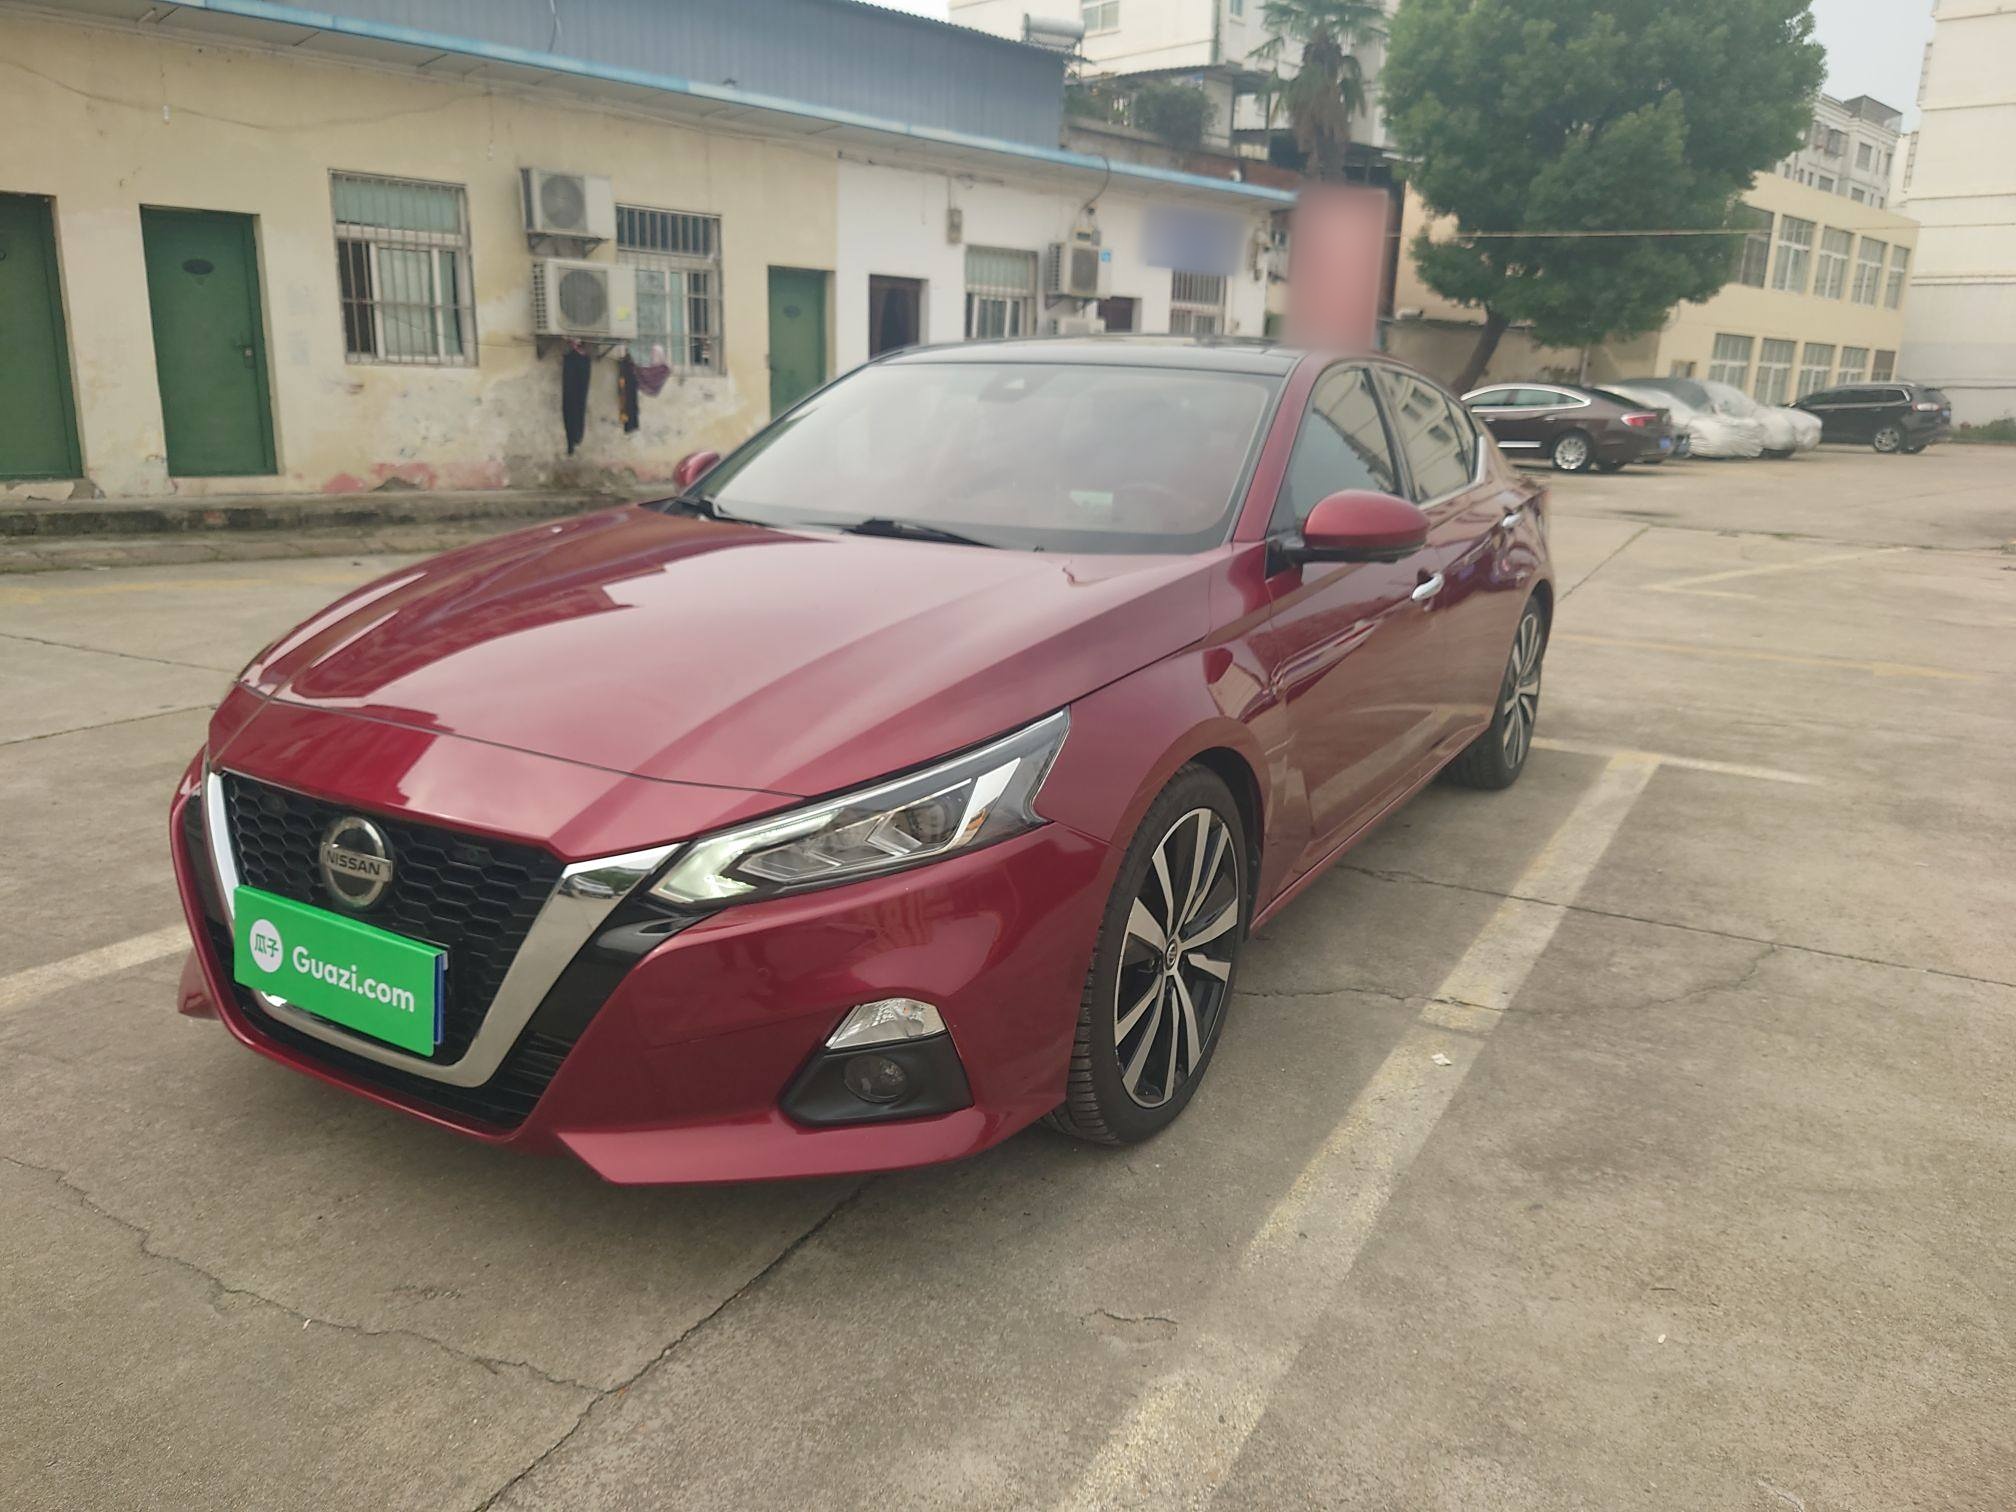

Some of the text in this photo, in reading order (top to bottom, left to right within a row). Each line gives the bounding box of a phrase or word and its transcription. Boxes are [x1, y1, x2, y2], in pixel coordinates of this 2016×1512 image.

[326, 850, 380, 876] NISSAN
[254, 933, 280, 958] 瓜子
[292, 945, 415, 1013] Guazi.com
